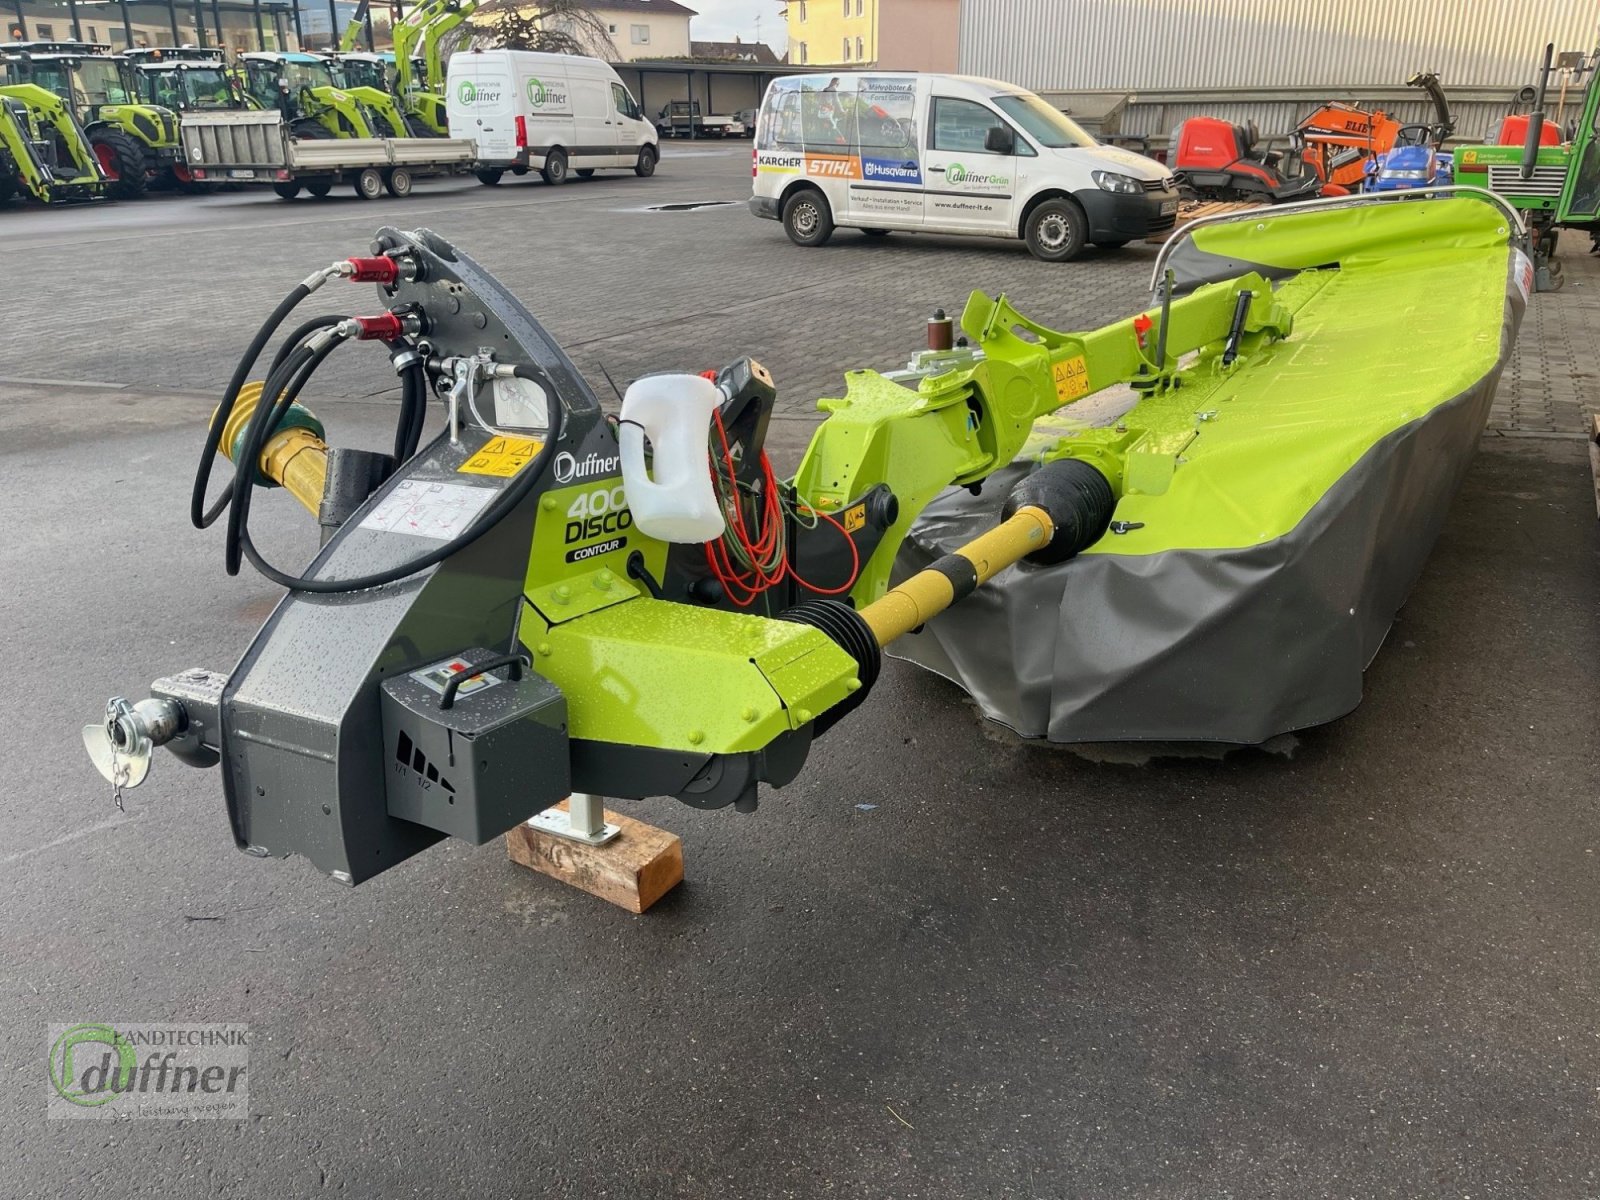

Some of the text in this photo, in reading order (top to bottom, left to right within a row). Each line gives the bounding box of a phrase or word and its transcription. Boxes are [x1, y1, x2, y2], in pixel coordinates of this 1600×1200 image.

[464, 88, 501, 102] duffner
[534, 88, 567, 104] duffner
[808, 159, 855, 176] STIHL
[874, 164, 918, 178] Husqvarna
[554, 451, 620, 484] Duffner
[567, 484, 629, 520] 400
[564, 508, 633, 545] DISCO
[573, 539, 620, 561] CONTOUR
[417, 776, 432, 792] 1/2
